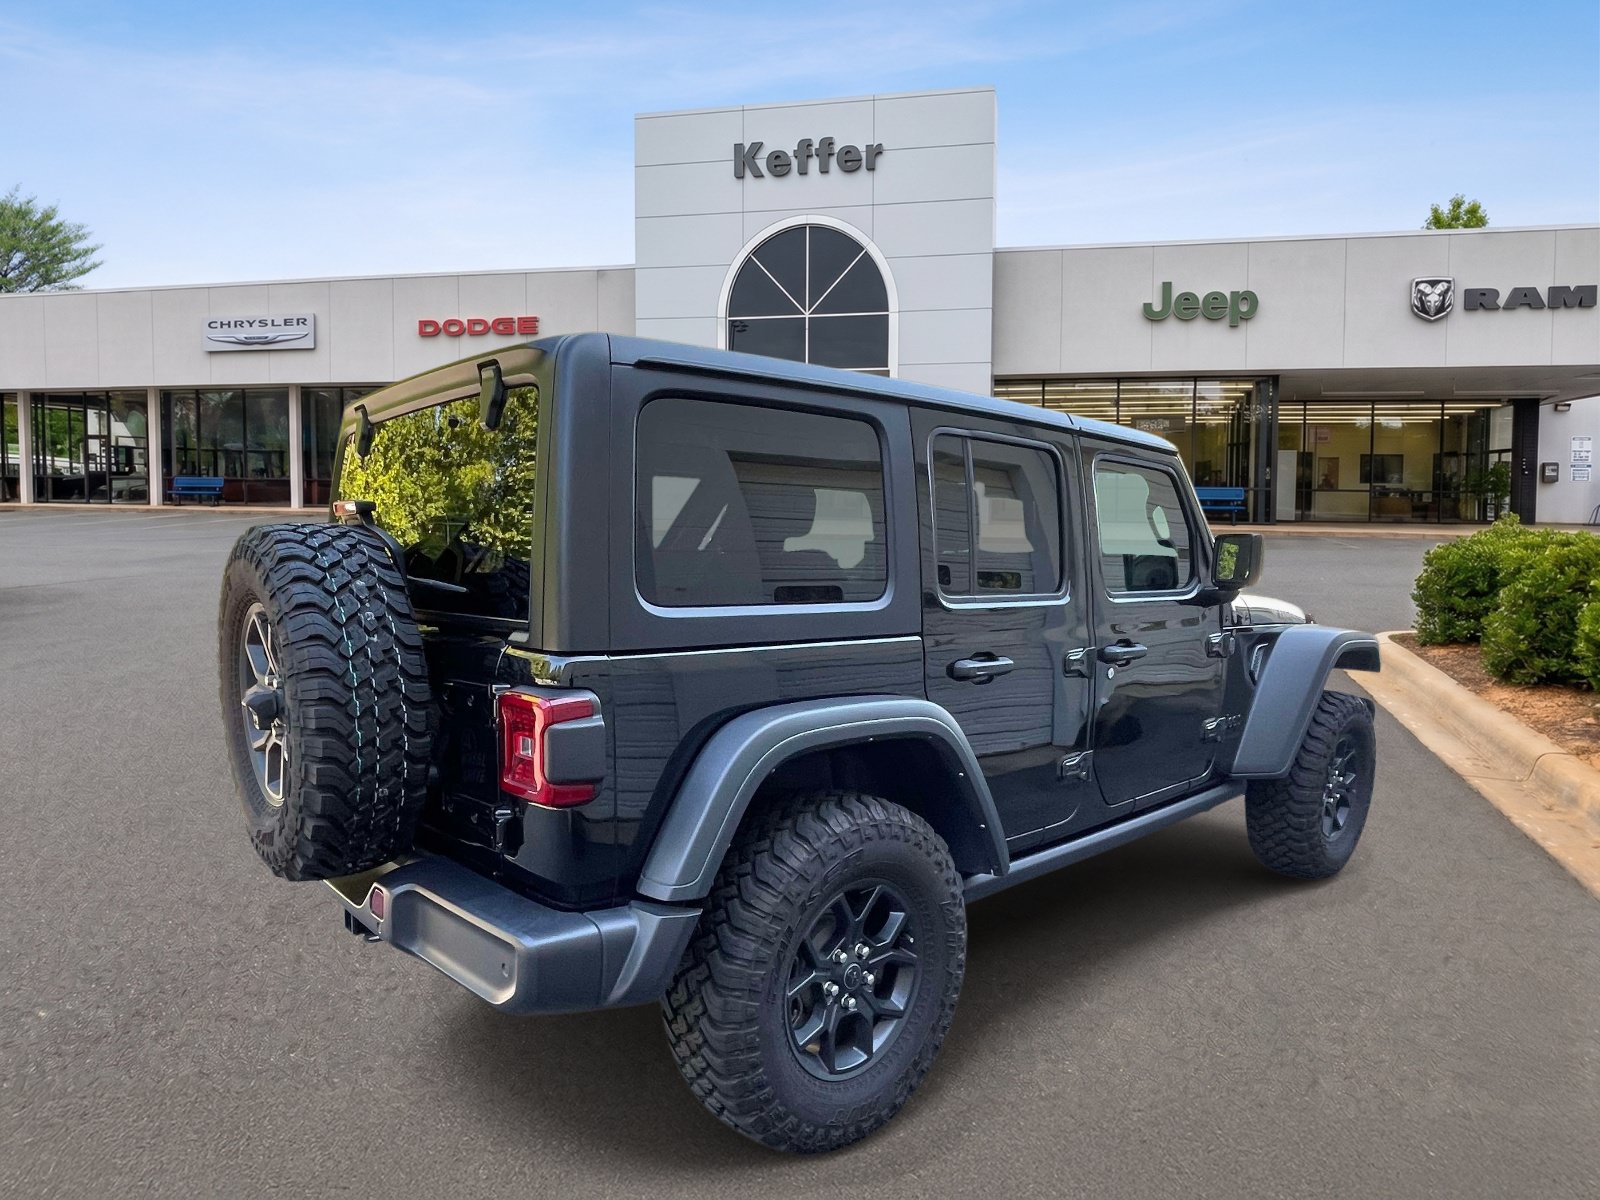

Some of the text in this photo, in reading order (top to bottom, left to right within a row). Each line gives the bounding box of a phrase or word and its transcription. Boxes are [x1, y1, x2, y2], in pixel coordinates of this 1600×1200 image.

[734, 137, 883, 178] Keffer
[1143, 281, 1259, 327] Jeep
[1464, 285, 1598, 310] RAM
[207, 317, 308, 329] CHRYSLER
[418, 317, 539, 337] DODGE
